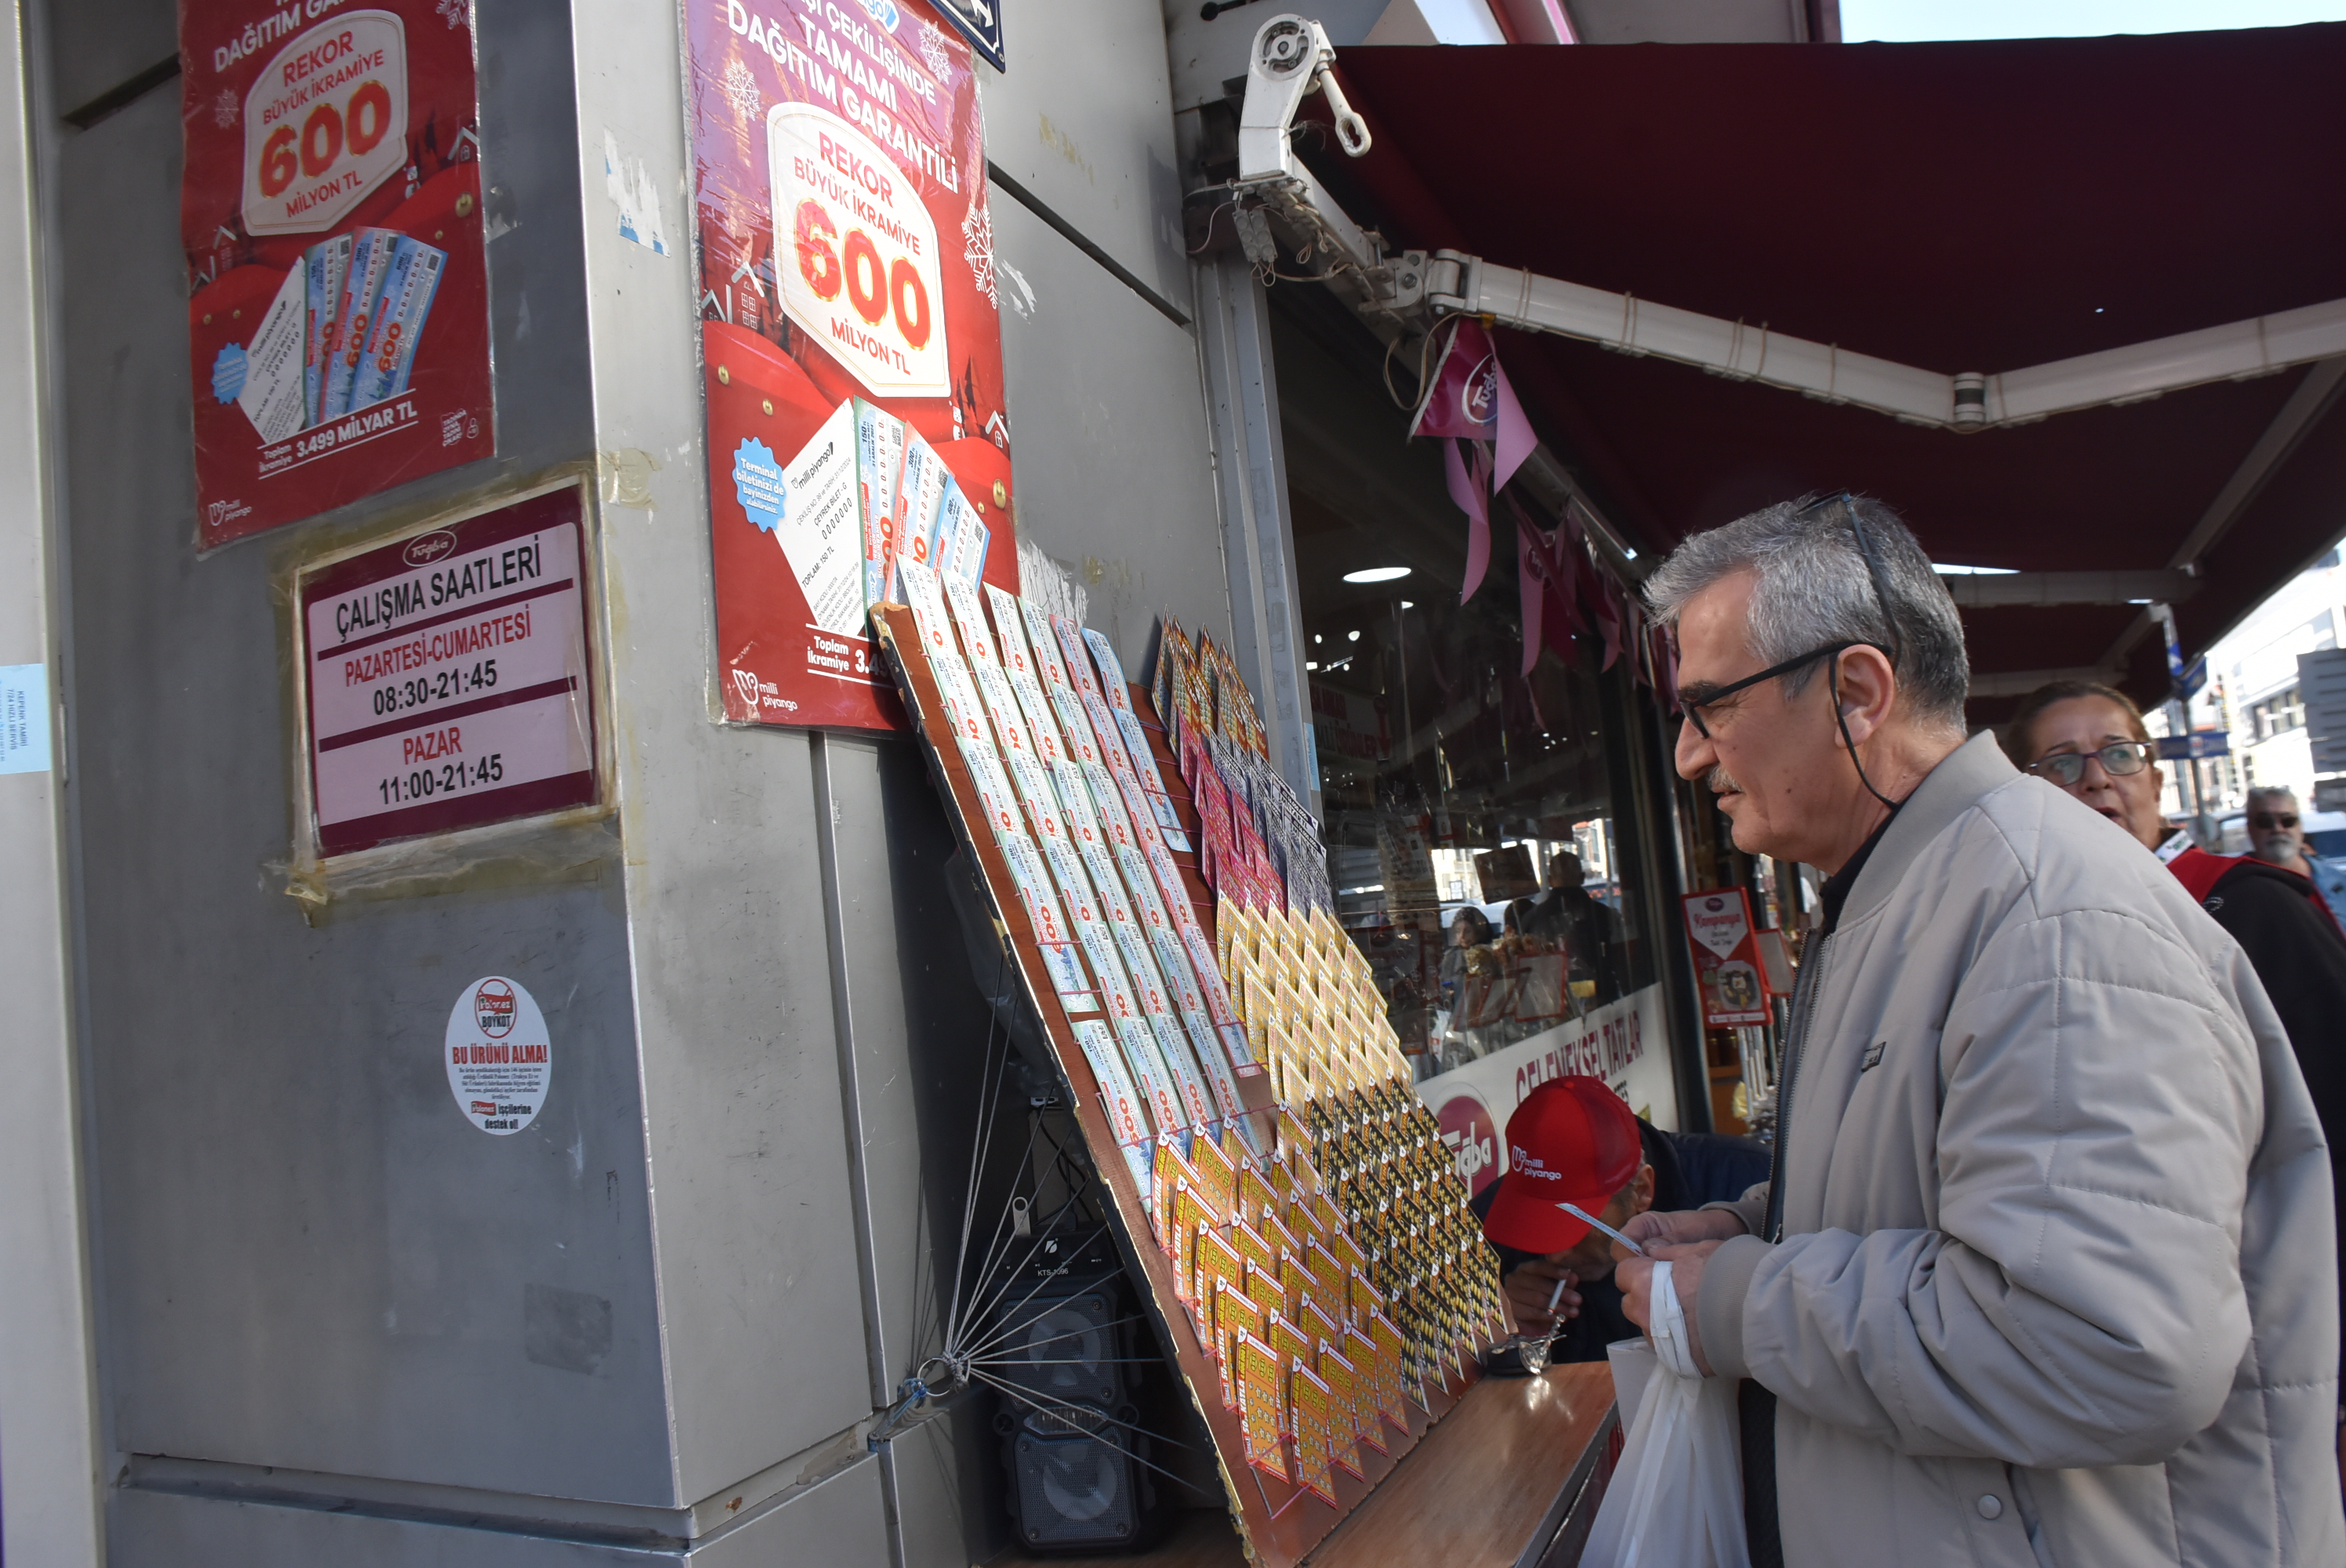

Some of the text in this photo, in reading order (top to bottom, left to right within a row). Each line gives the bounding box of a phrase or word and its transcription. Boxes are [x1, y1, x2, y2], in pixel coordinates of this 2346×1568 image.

[214, 3, 301, 73] DAĞITIM
[283, 31, 354, 86] REKOR
[800, 13, 898, 113] TAMAMI
[826, 2, 936, 106] ÇEKİLİŞİNDE
[263, 49, 384, 124] BÜYÜK İKRAMİYE
[727, 0, 959, 194] DAĞITIM GARANTİLİ
[259, 80, 391, 198] 600
[819, 131, 893, 209] REKOR
[285, 171, 361, 218] MİLYON TL
[794, 156, 921, 256] BÜYÜK İKRAMİYE
[794, 197, 931, 351] 600
[831, 317, 911, 376] MİLYON TL
[259, 402, 418, 474] İkramiye 3.499 MİLYAR TL
[860, 426, 869, 443] 150
[264, 444, 292, 461] Toplam
[906, 450, 916, 467] 300
[736, 468, 784, 495] biletinizi de
[741, 458, 777, 481] Terminal
[798, 447, 832, 489] milli piyango
[913, 466, 923, 485] ARALIK
[226, 500, 240, 512] milli
[743, 484, 779, 505] bayinizden
[814, 503, 831, 528] ÇEYREK
[830, 490, 841, 506] BİLET
[945, 500, 955, 514] 600
[225, 506, 252, 522] piyango
[797, 504, 812, 527] ÇEKİLİŞ
[802, 545, 835, 589] TOPLAM: 150 TL
[336, 534, 542, 643] ÇALIŞMA SAATLERİ
[345, 604, 532, 686] PAZARTESİ-CUMARTESİ
[808, 646, 849, 672] İkramiye
[814, 636, 849, 655] Toplam
[374, 659, 497, 715] 08:30-21:45
[759, 682, 778, 695] milli
[17, 691, 26, 720] KEPENK
[763, 695, 798, 711] piyango
[9, 724, 18, 750] SERVİS
[403, 727, 462, 764] PAZAR
[380, 753, 503, 804] 11:00-21:45
[1215, 924, 1226, 947] KATLA
[482, 1015, 511, 1028] BOYKOT
[1244, 1003, 1257, 1025] KATLA
[452, 1043, 547, 1064] BU ÜRÜNÜ ALMA!
[485, 1120, 508, 1129] destek
[499, 1104, 532, 1116] işçilerine
[1524, 1159, 1544, 1169] milli
[1524, 1168, 1562, 1181] piyango
[1151, 1174, 1164, 1204] KATLA
[1171, 1223, 1185, 1254] KATLA
[1193, 1269, 1206, 1301] KATLA
[1214, 1327, 1229, 1359] KATLA
[1235, 1379, 1250, 1413] KATLA
[1288, 1406, 1303, 1438] KATLA
